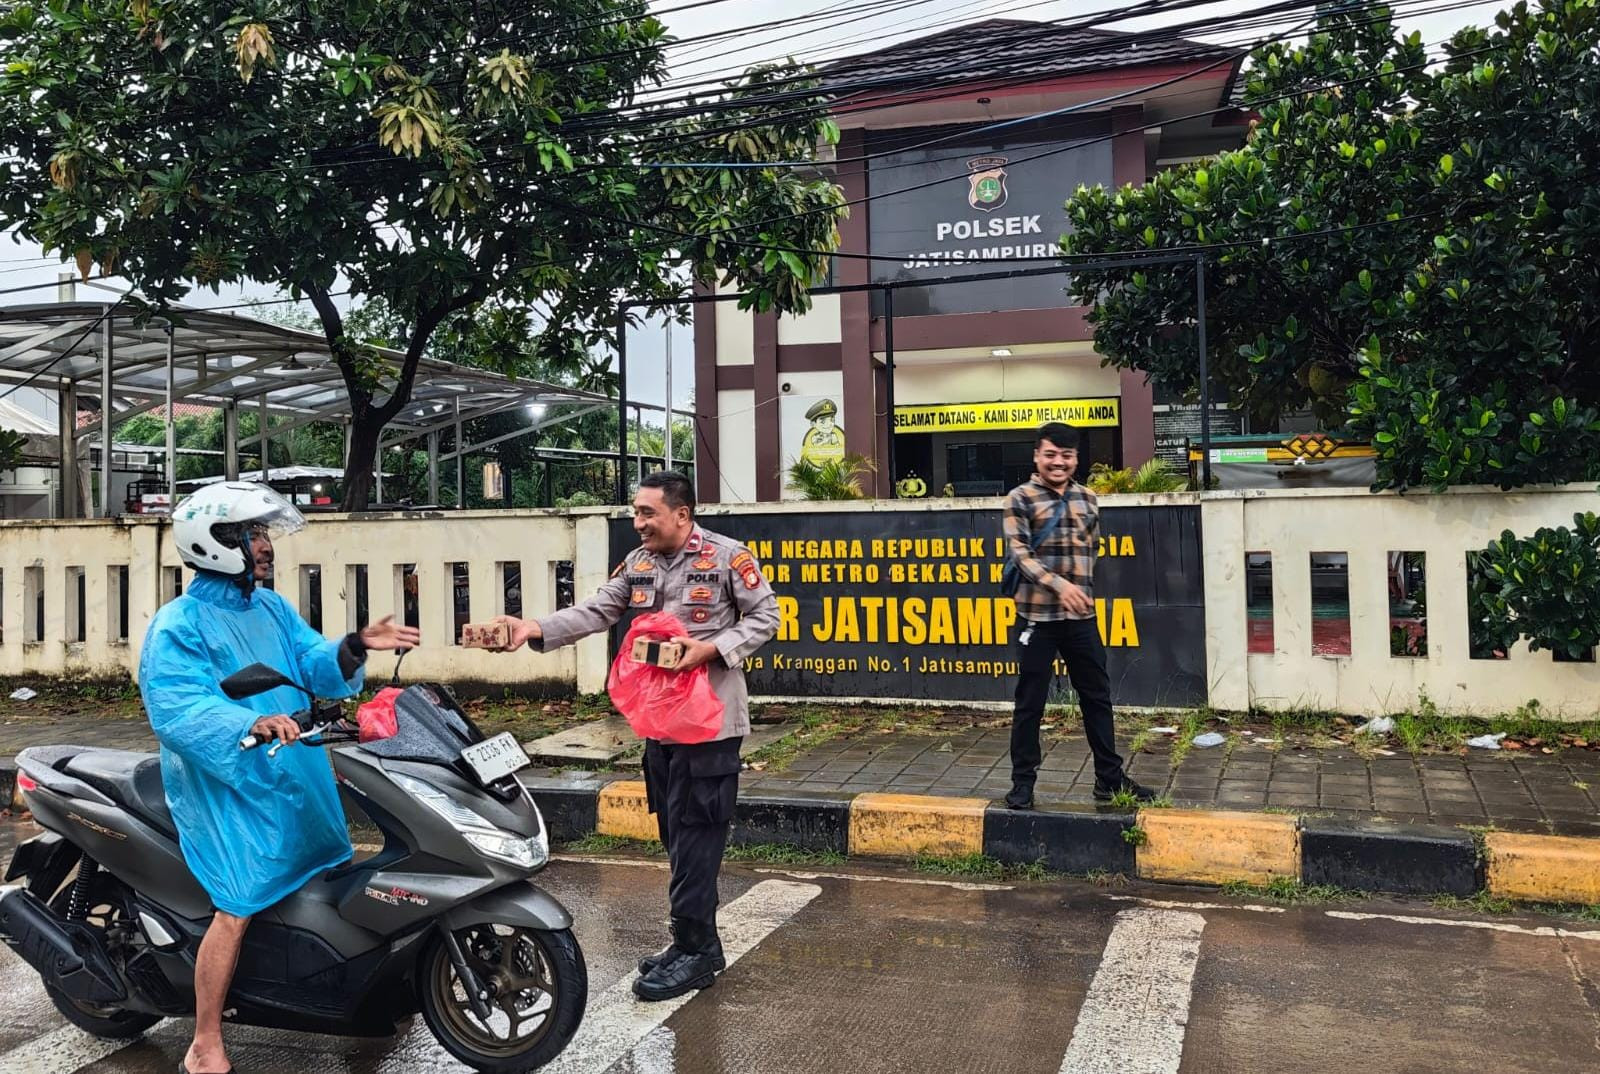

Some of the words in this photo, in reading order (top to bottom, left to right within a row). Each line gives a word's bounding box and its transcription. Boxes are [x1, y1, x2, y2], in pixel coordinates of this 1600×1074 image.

[936, 215, 1042, 241] POLSEK
[903, 243, 1062, 269] JATISAMPURN
[894, 412, 936, 427] SELAMAT
[938, 411, 976, 425] DATANG
[984, 410, 1008, 423] KAMI
[1011, 409, 1033, 422] SIAP
[1036, 407, 1085, 422] MELAYANI
[1087, 406, 1115, 420] ANDA
[1156, 439, 1185, 447] CATUR
[781, 540, 863, 559] NEGARA
[871, 537, 985, 558] REPUBLIK
[687, 573, 719, 583] POLRI
[801, 564, 879, 583] METRO
[890, 563, 980, 584] BEKASI
[773, 654, 857, 674] Kranggan
